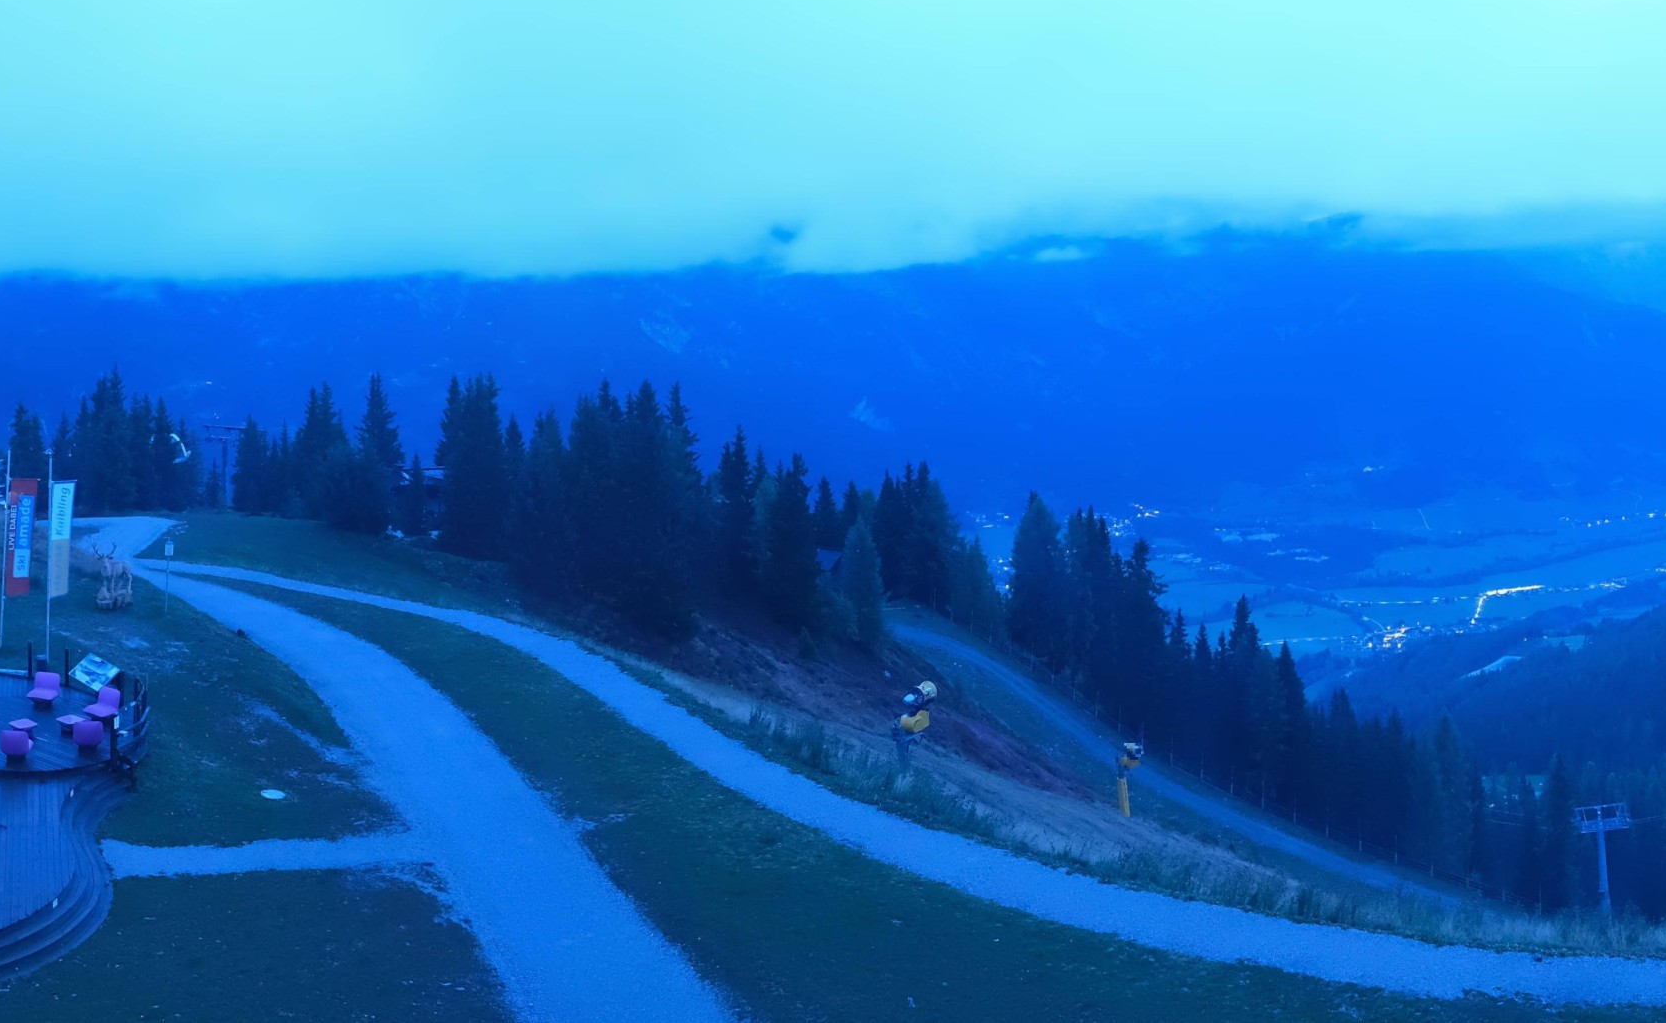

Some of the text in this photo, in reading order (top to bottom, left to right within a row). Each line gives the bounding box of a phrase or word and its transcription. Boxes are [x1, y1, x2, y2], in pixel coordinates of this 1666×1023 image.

[55, 487, 70, 536] Kaibling
[8, 531, 16, 550] LIVE
[17, 555, 26, 571] Ski
